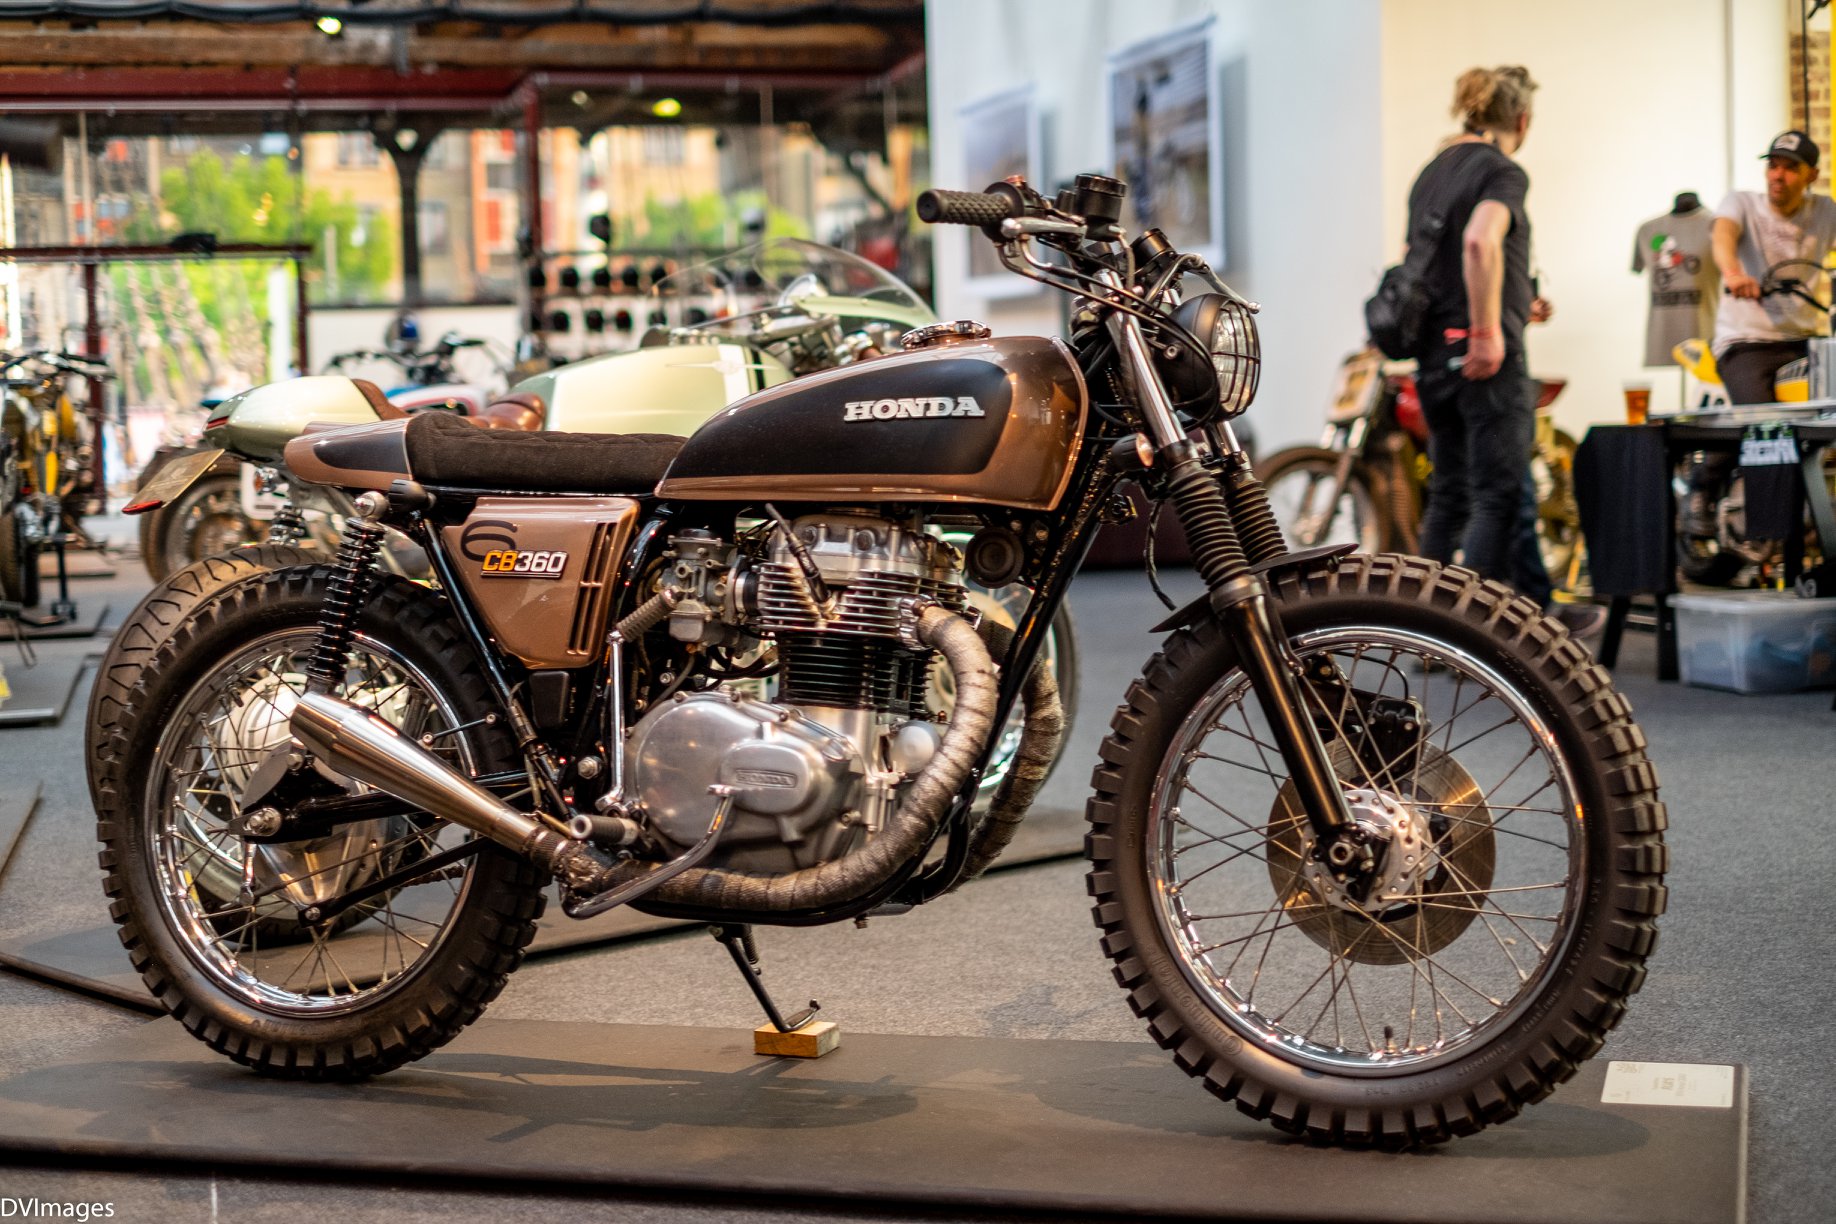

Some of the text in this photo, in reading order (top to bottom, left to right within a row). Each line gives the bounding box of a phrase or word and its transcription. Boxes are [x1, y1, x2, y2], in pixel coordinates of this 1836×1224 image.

[843, 396, 986, 422] HONDA
[461, 520, 518, 562] 6
[481, 550, 568, 573] CB360
[736, 771, 794, 786] HONDA
